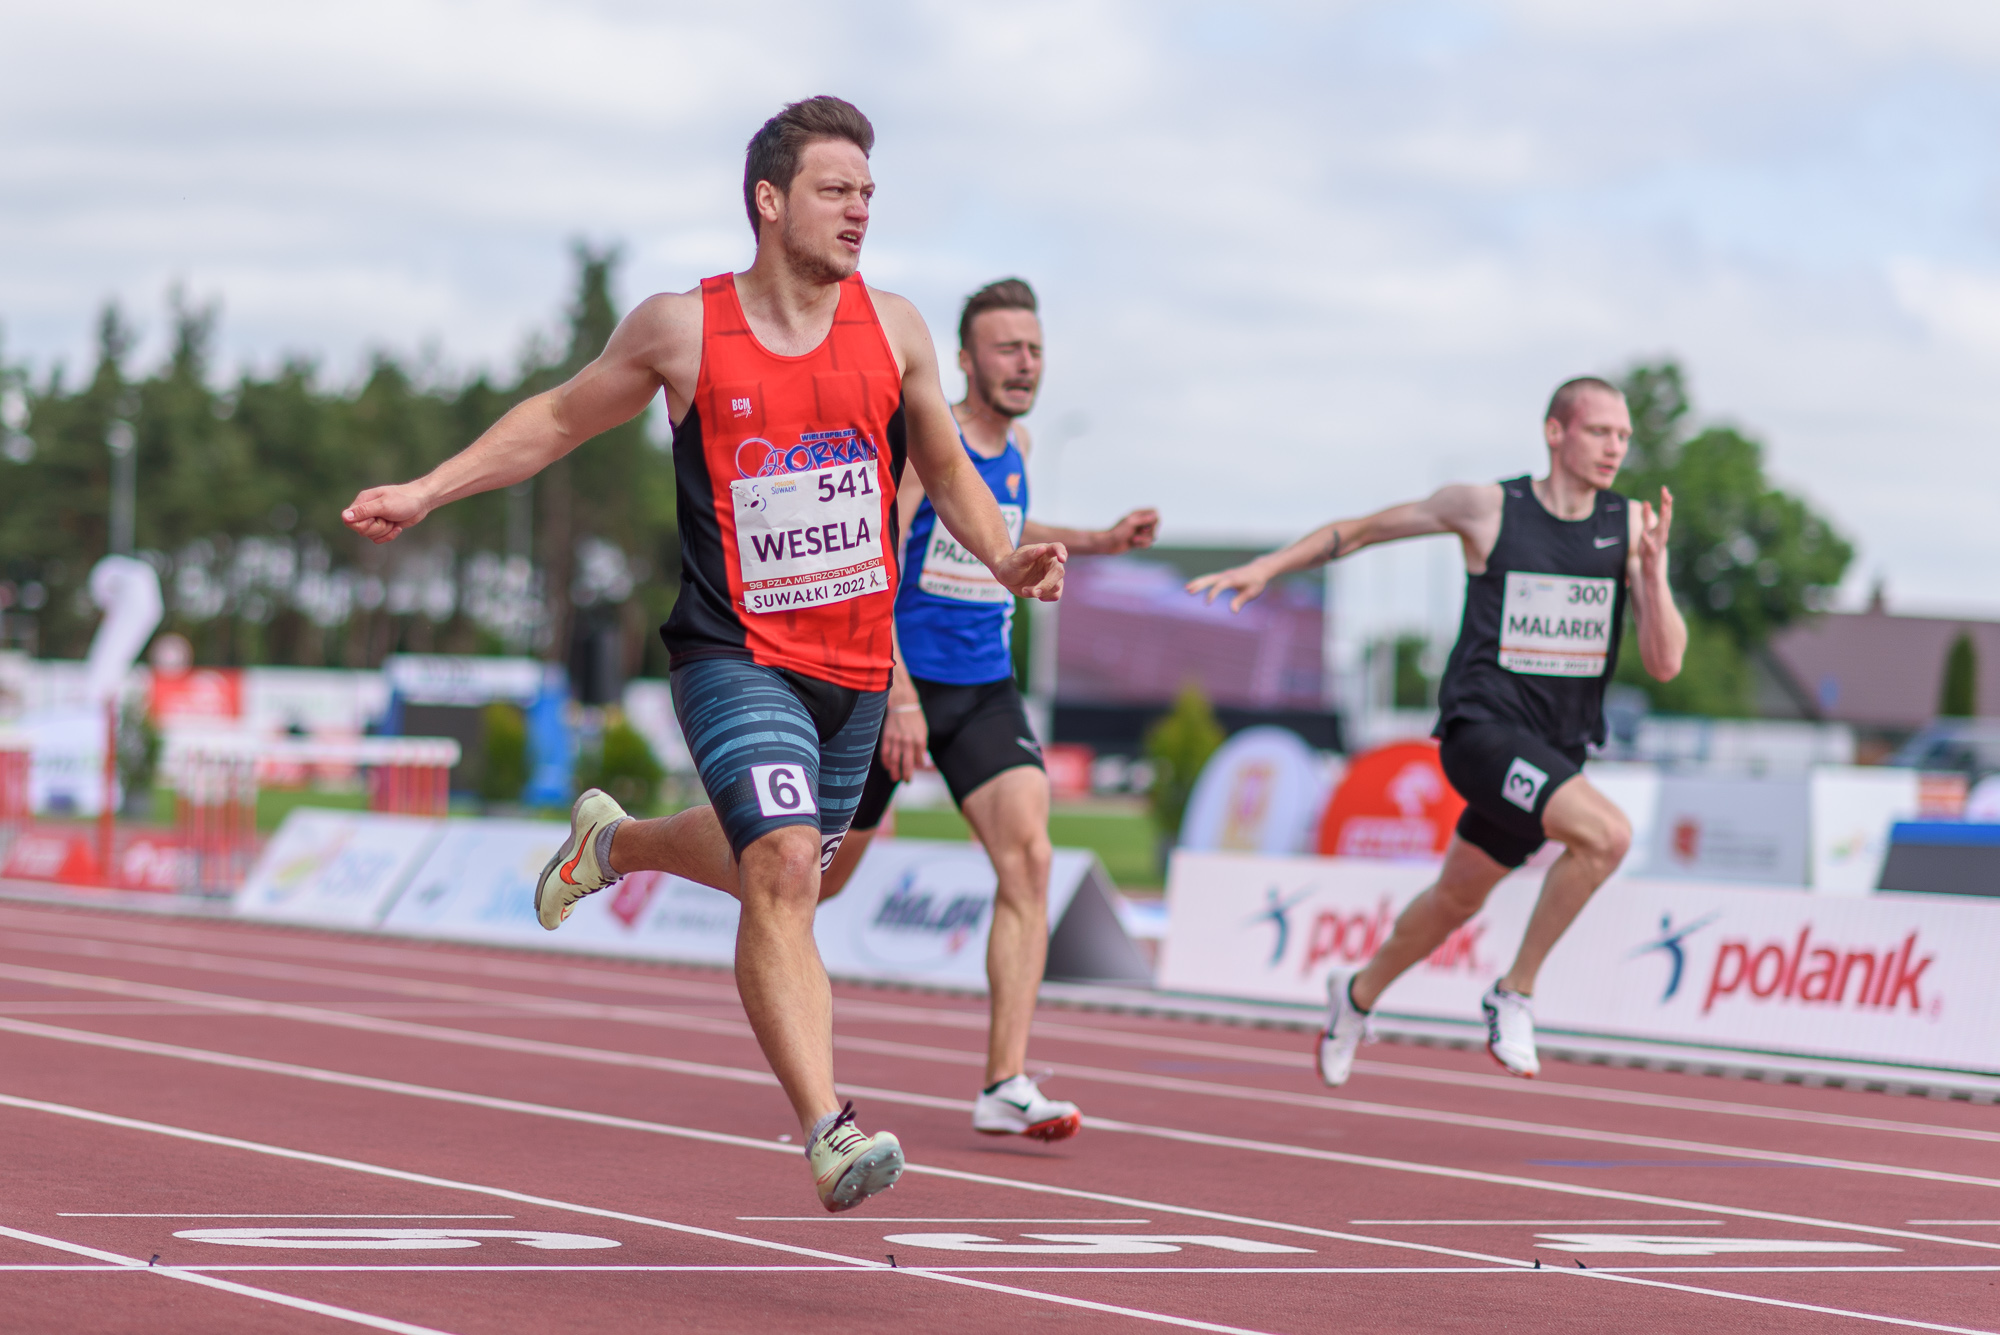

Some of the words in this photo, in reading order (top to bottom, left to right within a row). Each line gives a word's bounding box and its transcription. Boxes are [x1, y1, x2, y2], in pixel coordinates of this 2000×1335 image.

[732, 398, 751, 411] BCM
[785, 434, 878, 472] ORKAN
[818, 466, 874, 502] 541
[751, 517, 870, 562] WESELA
[749, 581, 766, 590] 98.
[767, 578, 793, 588] PZLA
[794, 566, 856, 585] MISTRZOSTWA
[856, 558, 880, 572] POLSKI
[753, 585, 828, 609] SUWAŁKI
[833, 577, 866, 597] 2022
[1568, 584, 1608, 606] 300
[1508, 614, 1606, 640] MALAREK
[768, 768, 801, 810] 6
[1510, 773, 1534, 799] 3
[821, 835, 844, 867] 6
[1701, 922, 1934, 1016] polanik
